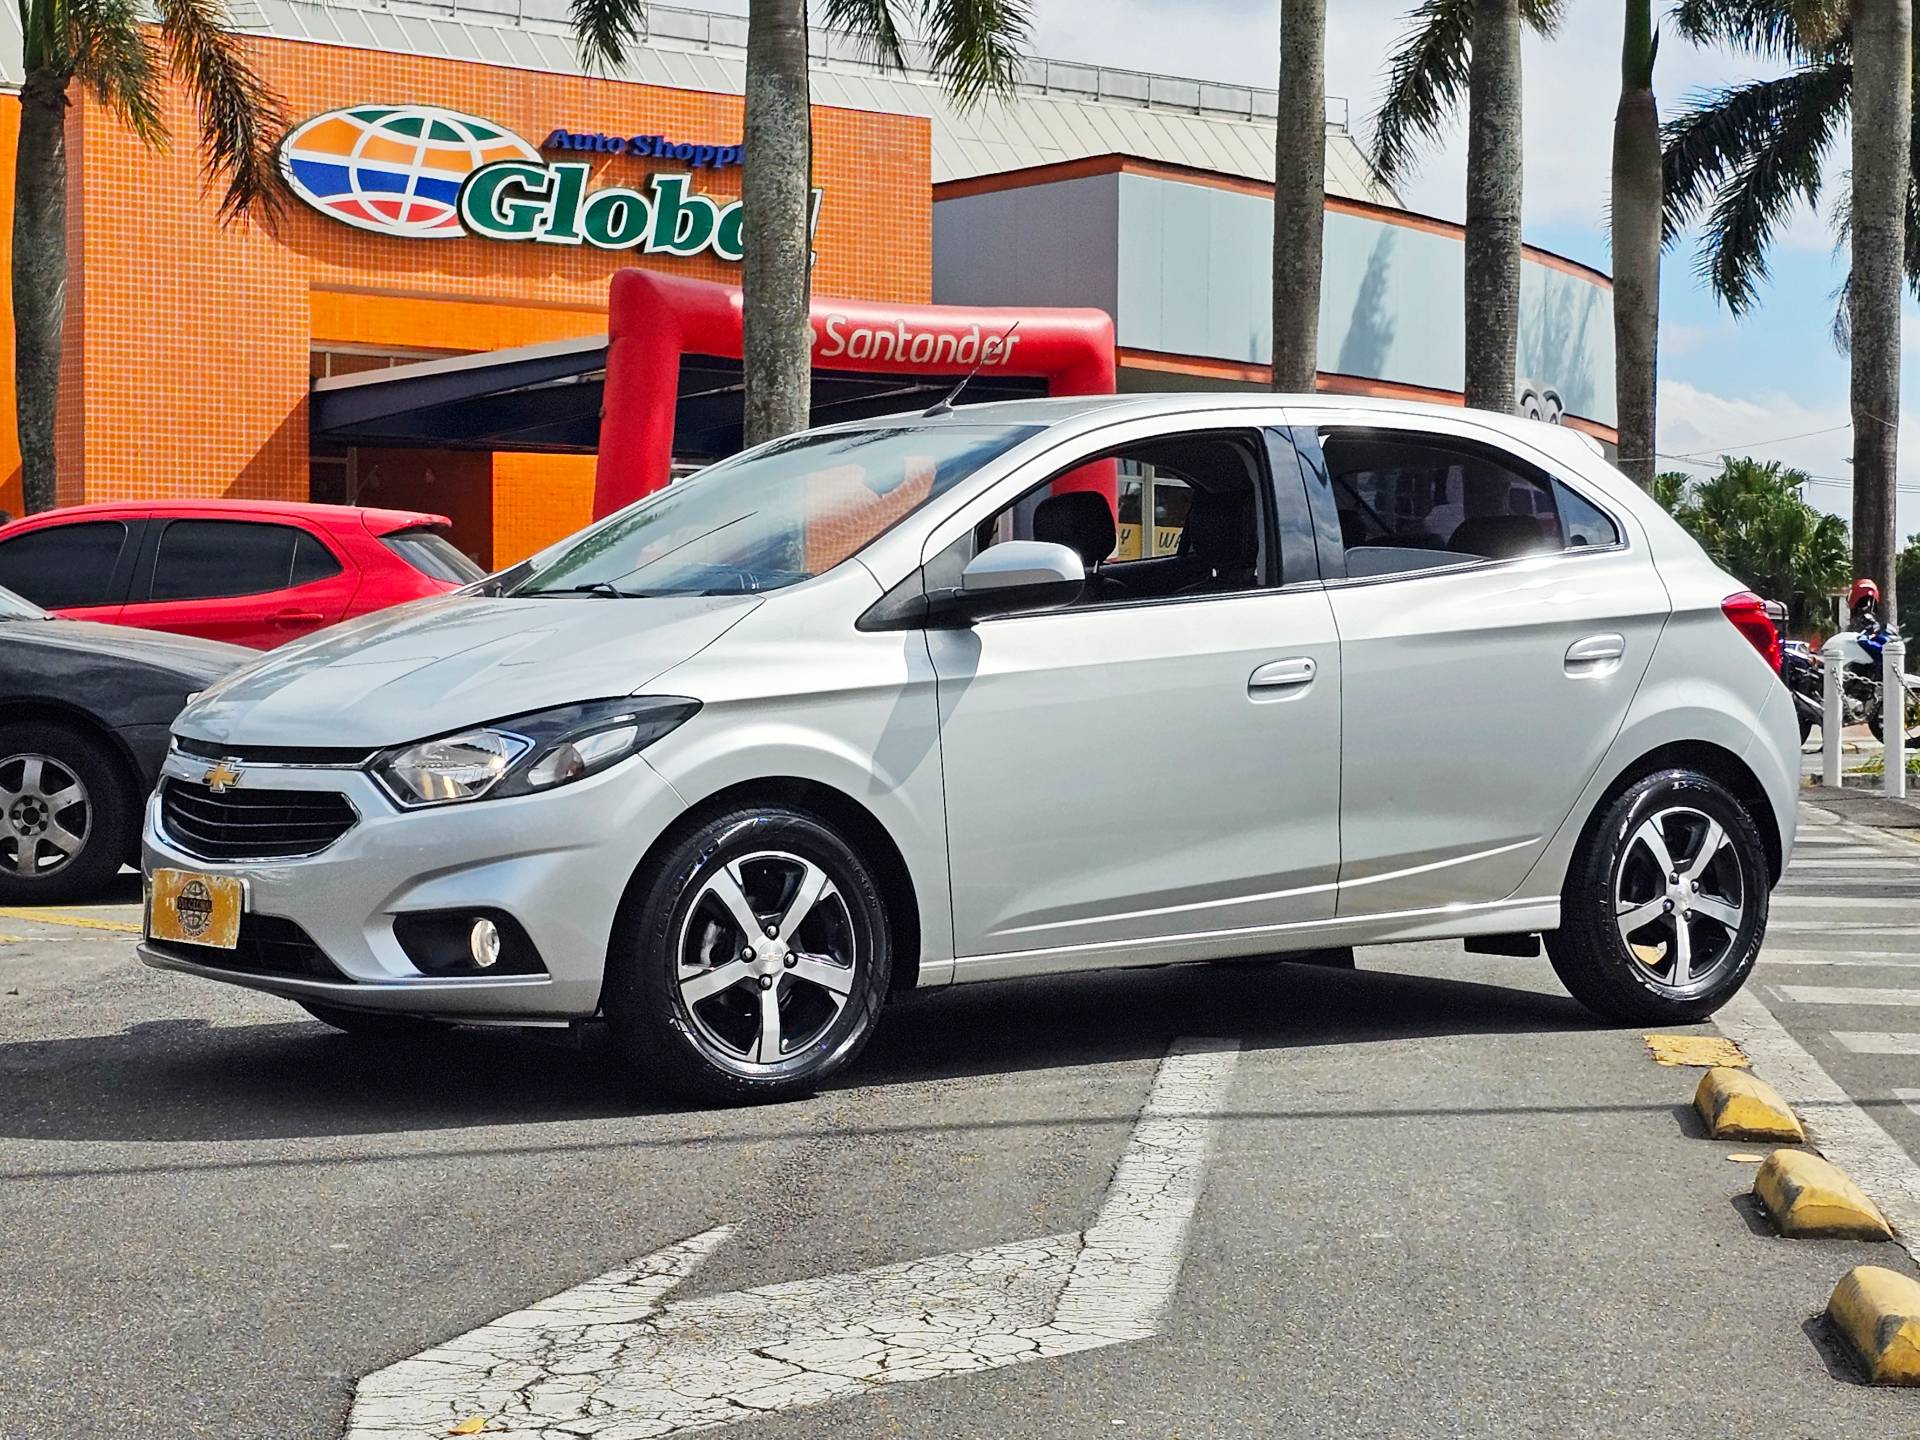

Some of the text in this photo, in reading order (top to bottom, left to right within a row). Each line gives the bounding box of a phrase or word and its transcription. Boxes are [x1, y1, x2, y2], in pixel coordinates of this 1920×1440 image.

[544, 129, 745, 168] Auto Shoppi
[460, 160, 822, 268] Glob
[819, 312, 1021, 366] Santander
